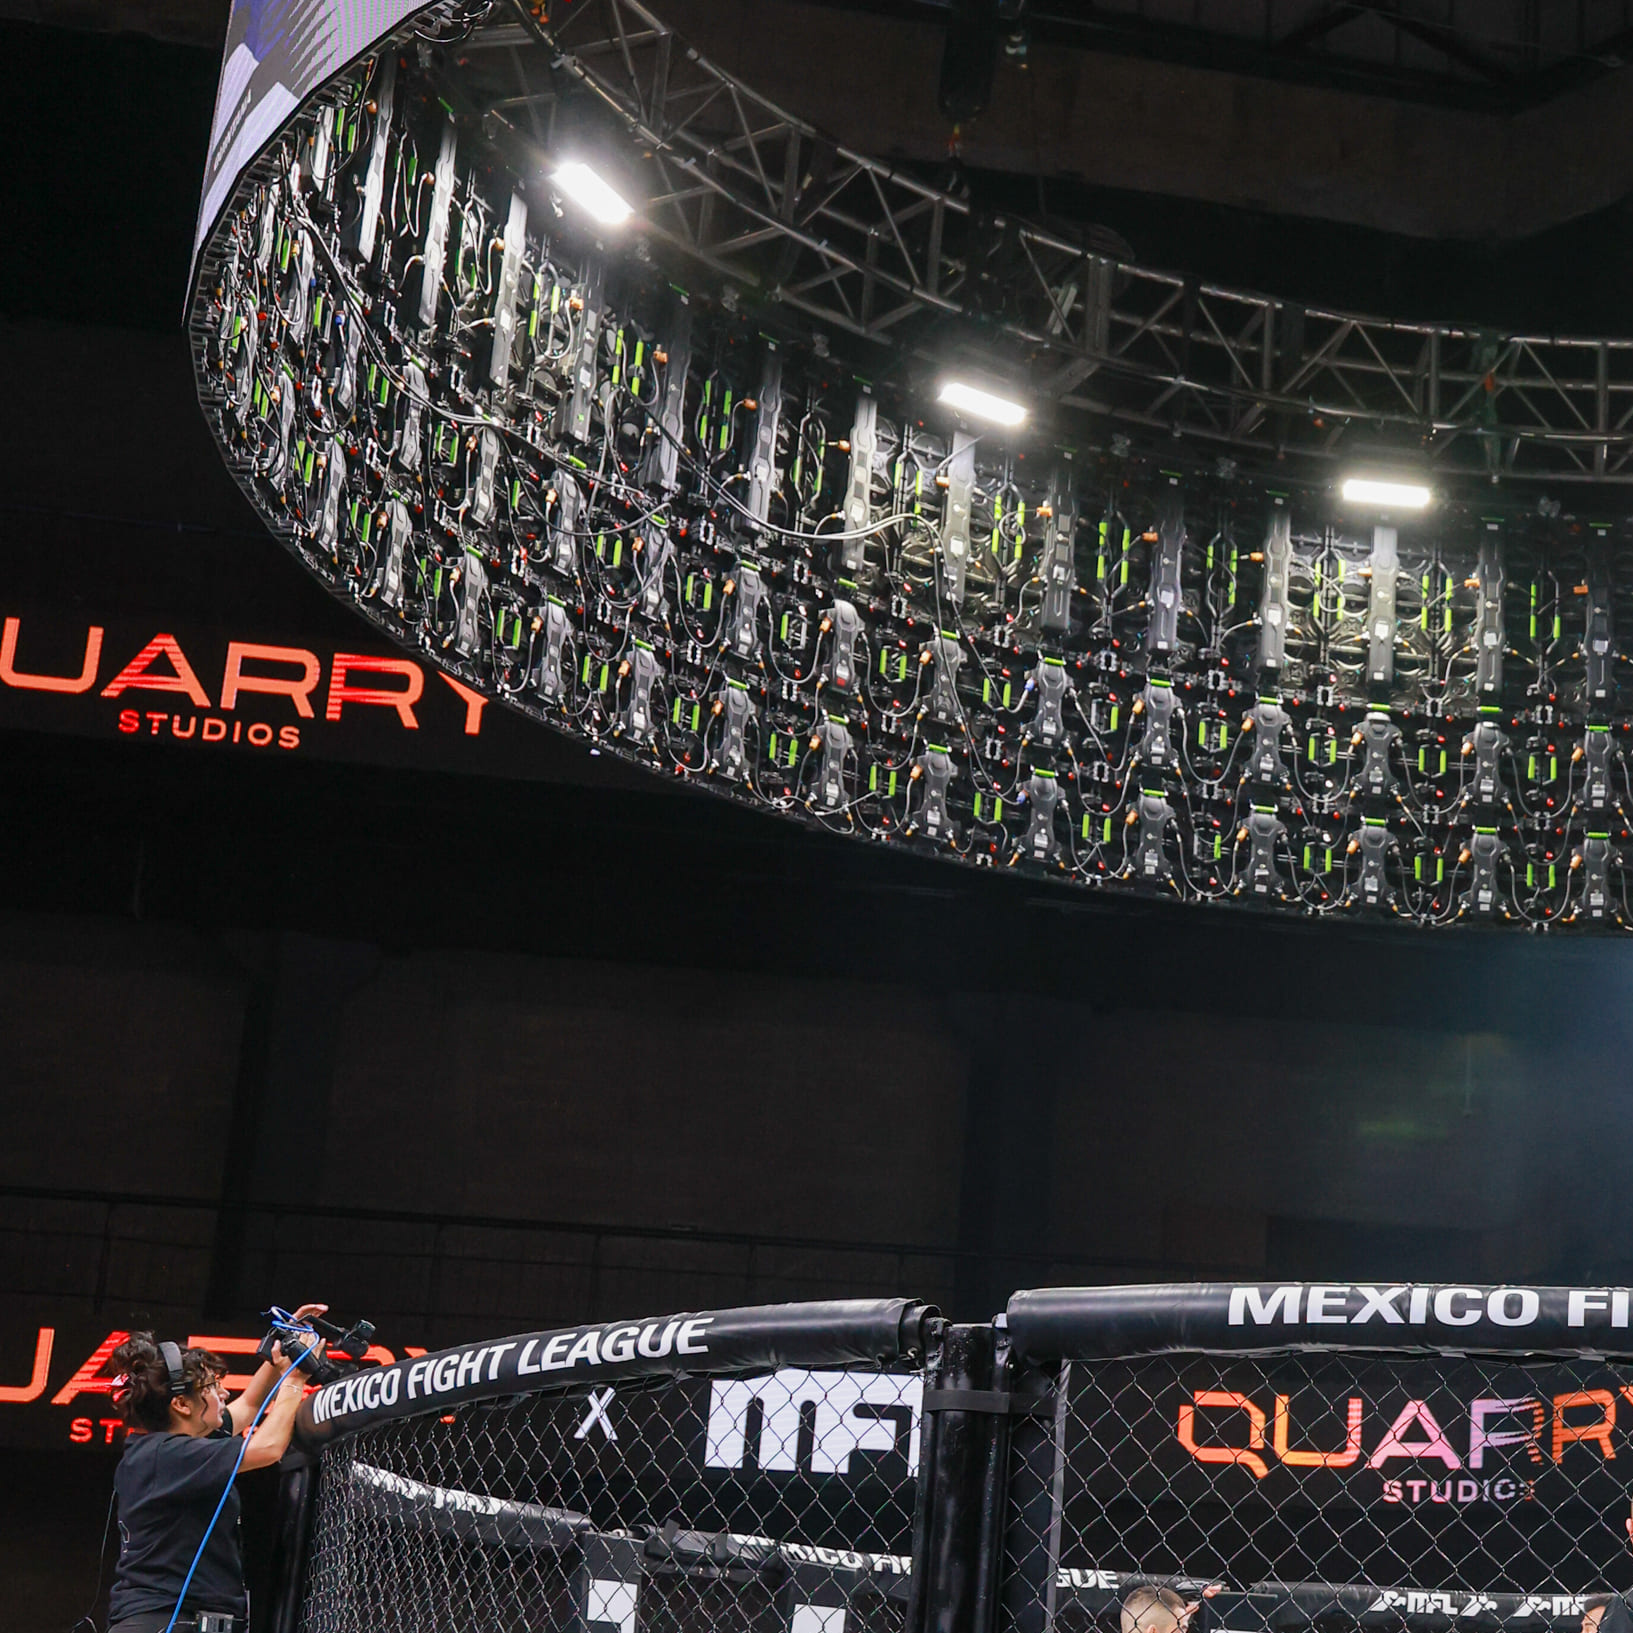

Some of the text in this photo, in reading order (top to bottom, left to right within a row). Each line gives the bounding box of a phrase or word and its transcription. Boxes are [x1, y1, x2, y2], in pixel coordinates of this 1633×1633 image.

[0, 617, 488, 736] UARRY
[118, 709, 301, 749] STUDIOS
[1227, 1286, 1540, 1327] MEXICO
[313, 1369, 400, 1425] MEXICO
[406, 1342, 518, 1401] FIGHT
[516, 1317, 714, 1374] LEAGUE
[574, 1386, 617, 1440] X
